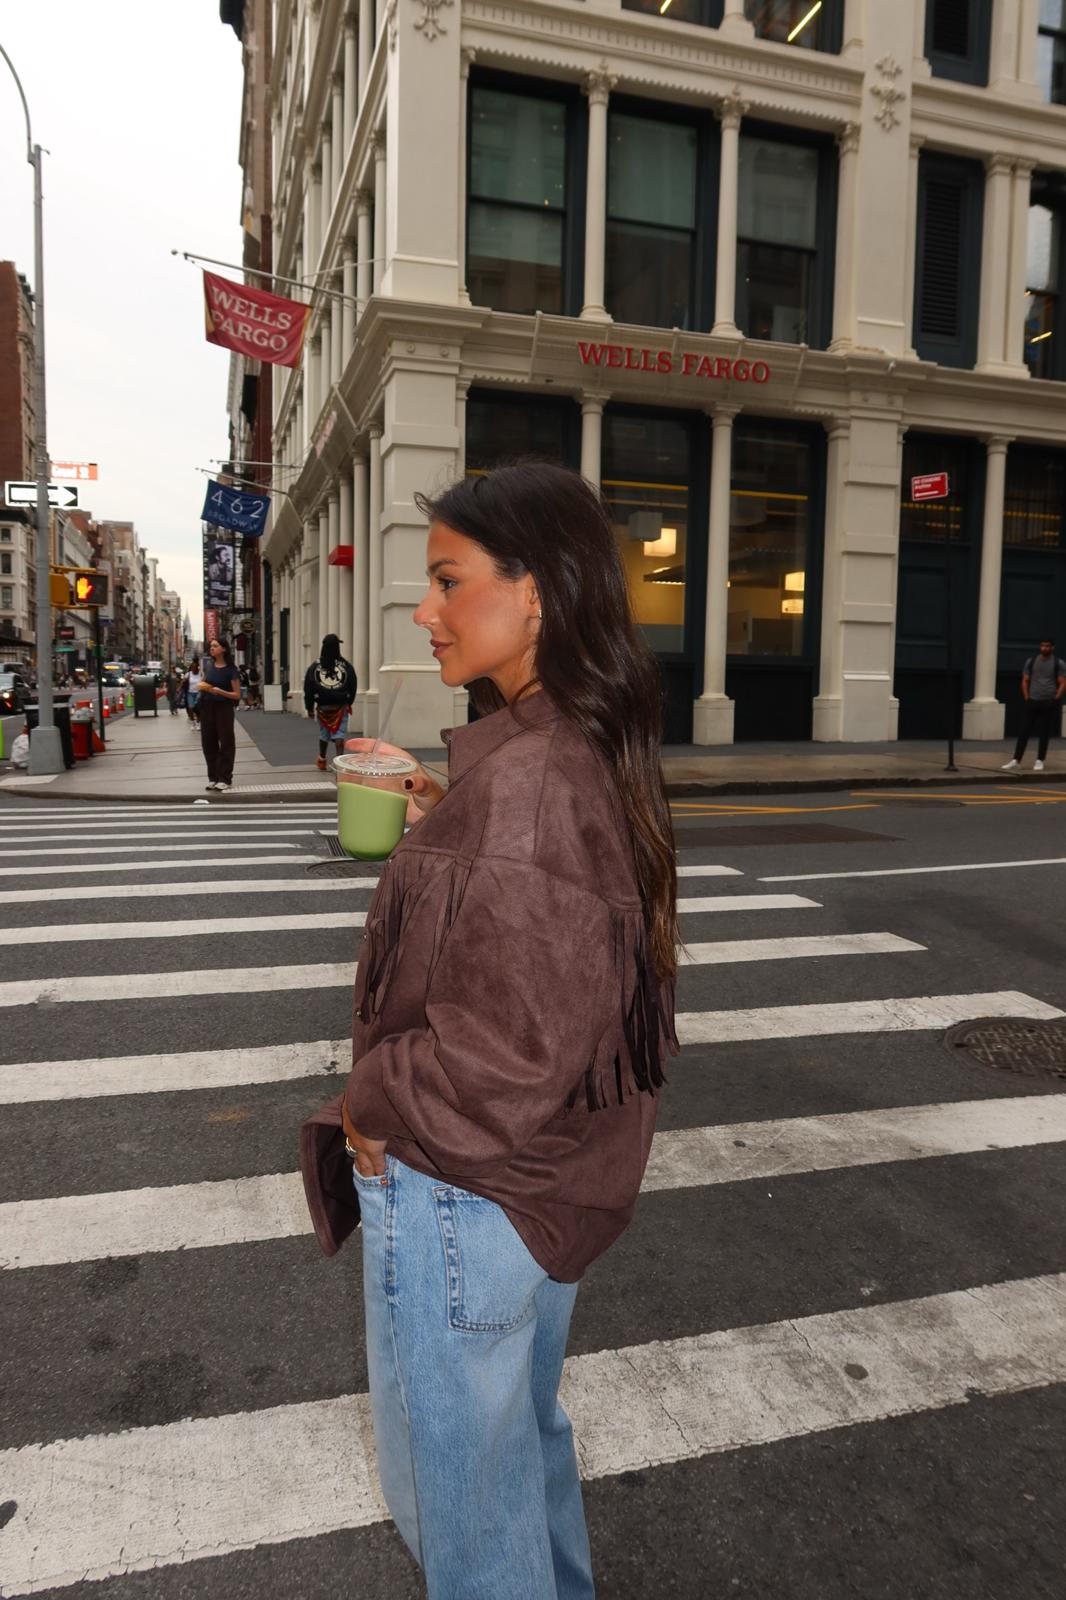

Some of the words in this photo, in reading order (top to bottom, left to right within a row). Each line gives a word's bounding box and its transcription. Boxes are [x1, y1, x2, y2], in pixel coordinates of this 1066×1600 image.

[212, 286, 292, 330] WELLS
[577, 341, 672, 374] WELLS
[681, 352, 771, 384] FARGO
